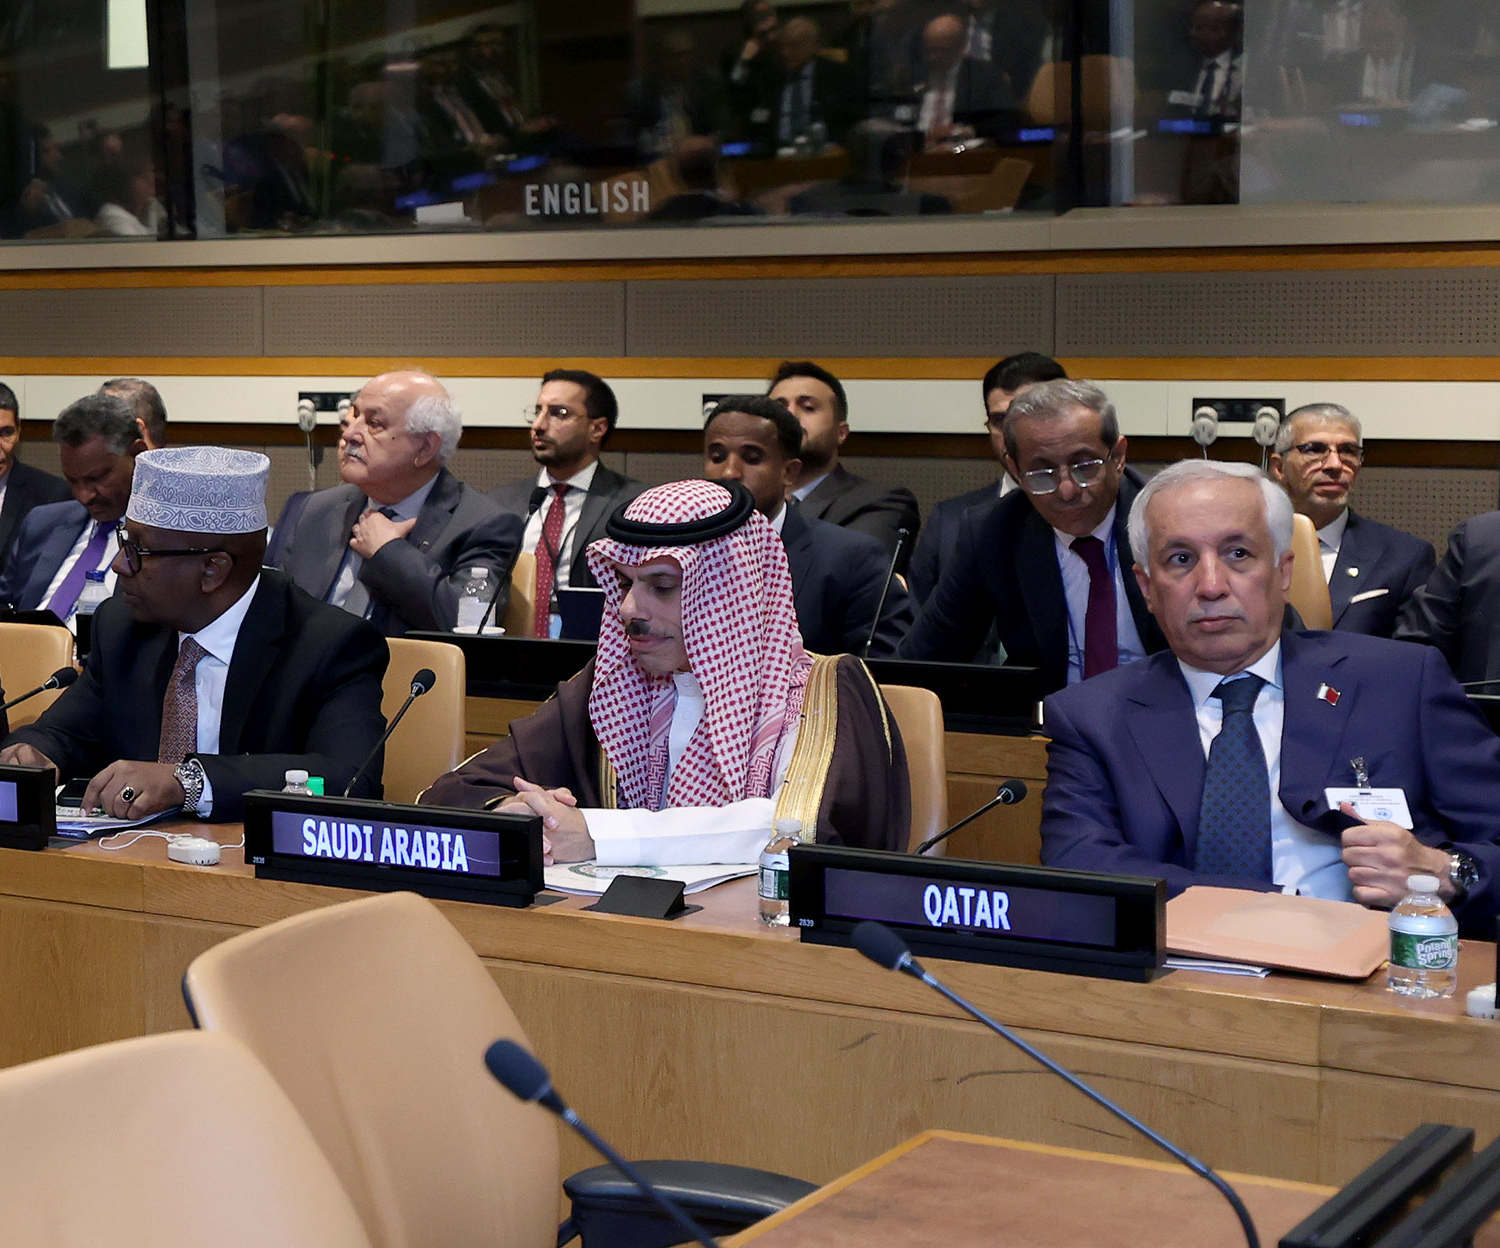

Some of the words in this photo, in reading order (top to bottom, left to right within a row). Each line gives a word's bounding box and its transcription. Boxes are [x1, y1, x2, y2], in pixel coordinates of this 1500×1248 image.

[525, 180, 650, 216] ENGLISH
[302, 818, 374, 862] SAUDI
[379, 827, 469, 872] ARABIA
[923, 884, 1012, 931] QATAR
[1415, 937, 1452, 955] Poland
[1417, 949, 1453, 966] Spring
